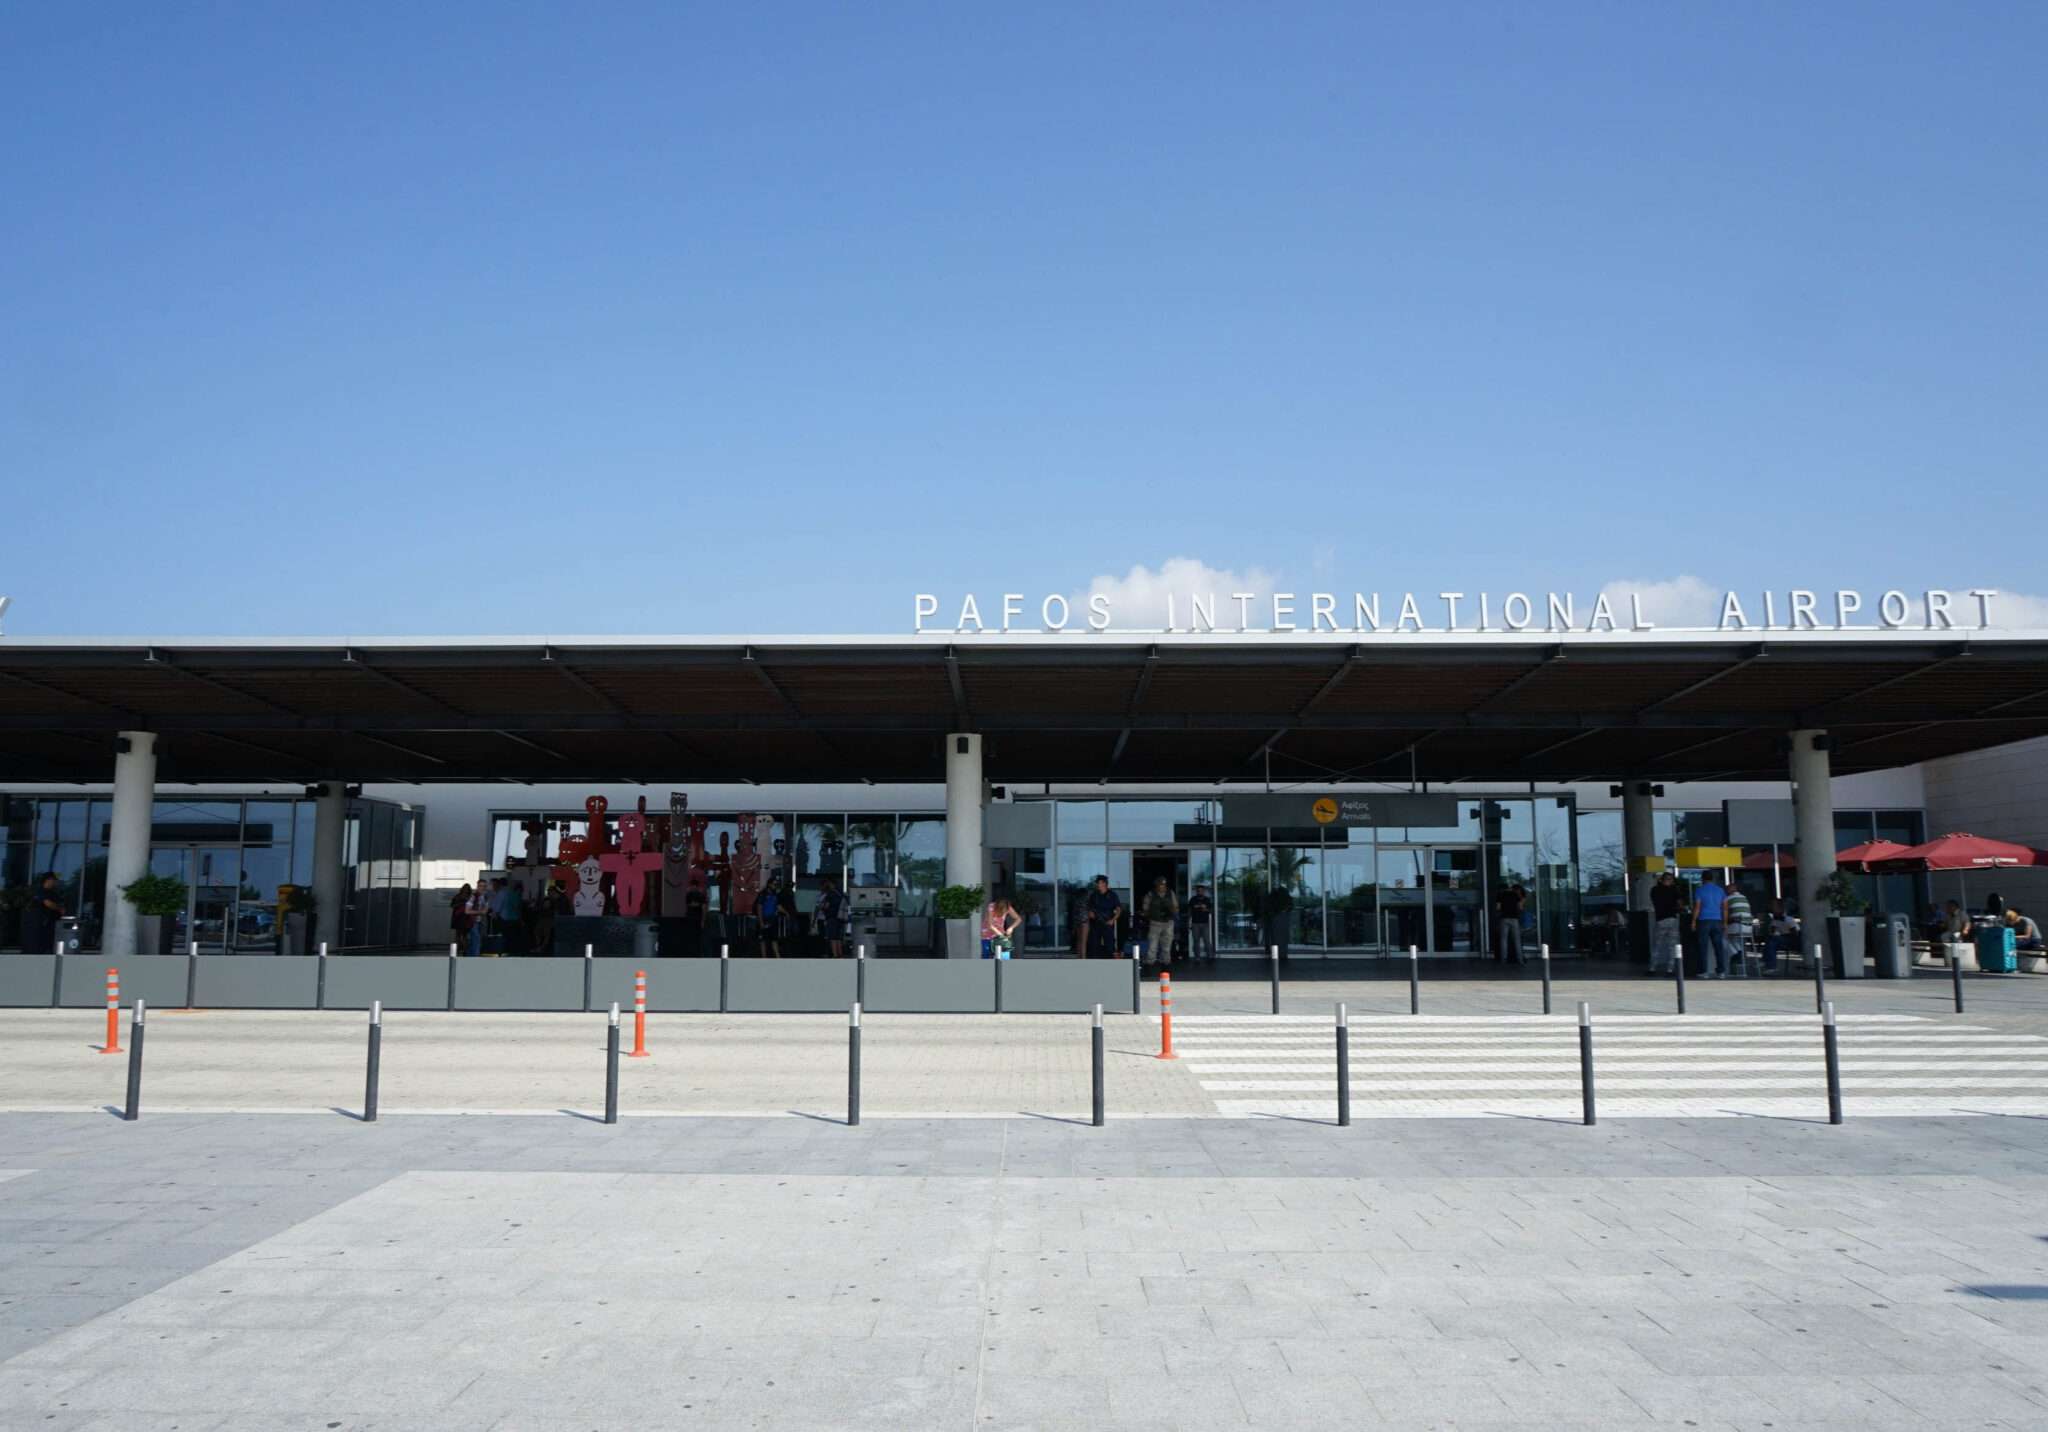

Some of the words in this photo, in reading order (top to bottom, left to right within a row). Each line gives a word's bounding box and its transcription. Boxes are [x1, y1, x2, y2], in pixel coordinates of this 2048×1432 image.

[915, 593, 1111, 630] PAFOS
[1167, 592, 1655, 630] INTERNATIONAL
[1719, 589, 1999, 628] AIRPORT
